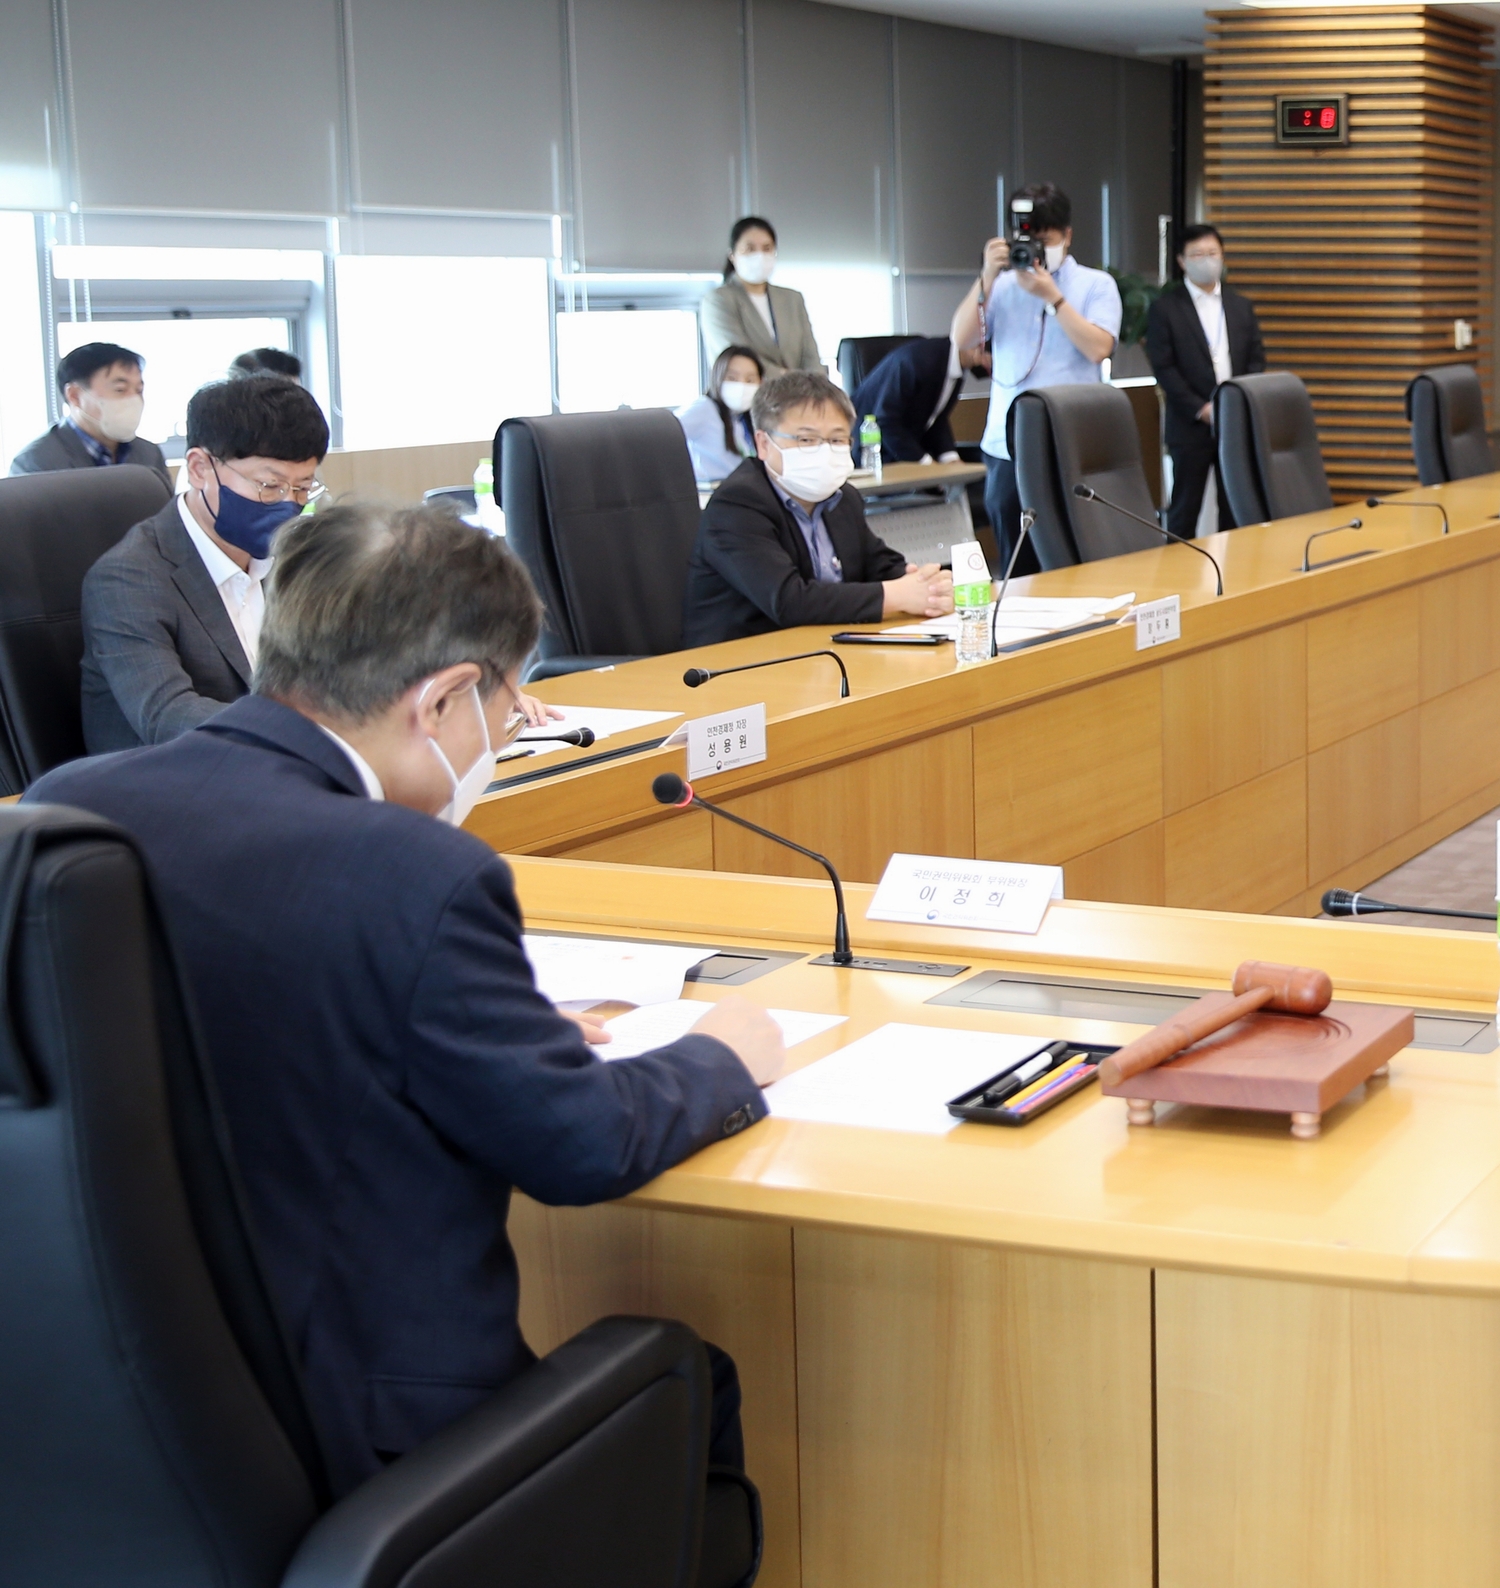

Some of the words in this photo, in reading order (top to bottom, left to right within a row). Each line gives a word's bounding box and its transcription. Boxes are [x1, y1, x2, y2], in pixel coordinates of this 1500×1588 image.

[707, 722, 733, 737] 인천경제청
[736, 719, 747, 730] 차장
[912, 869, 983, 884] 국민권익위원회
[987, 876, 1029, 888] 부위원장
